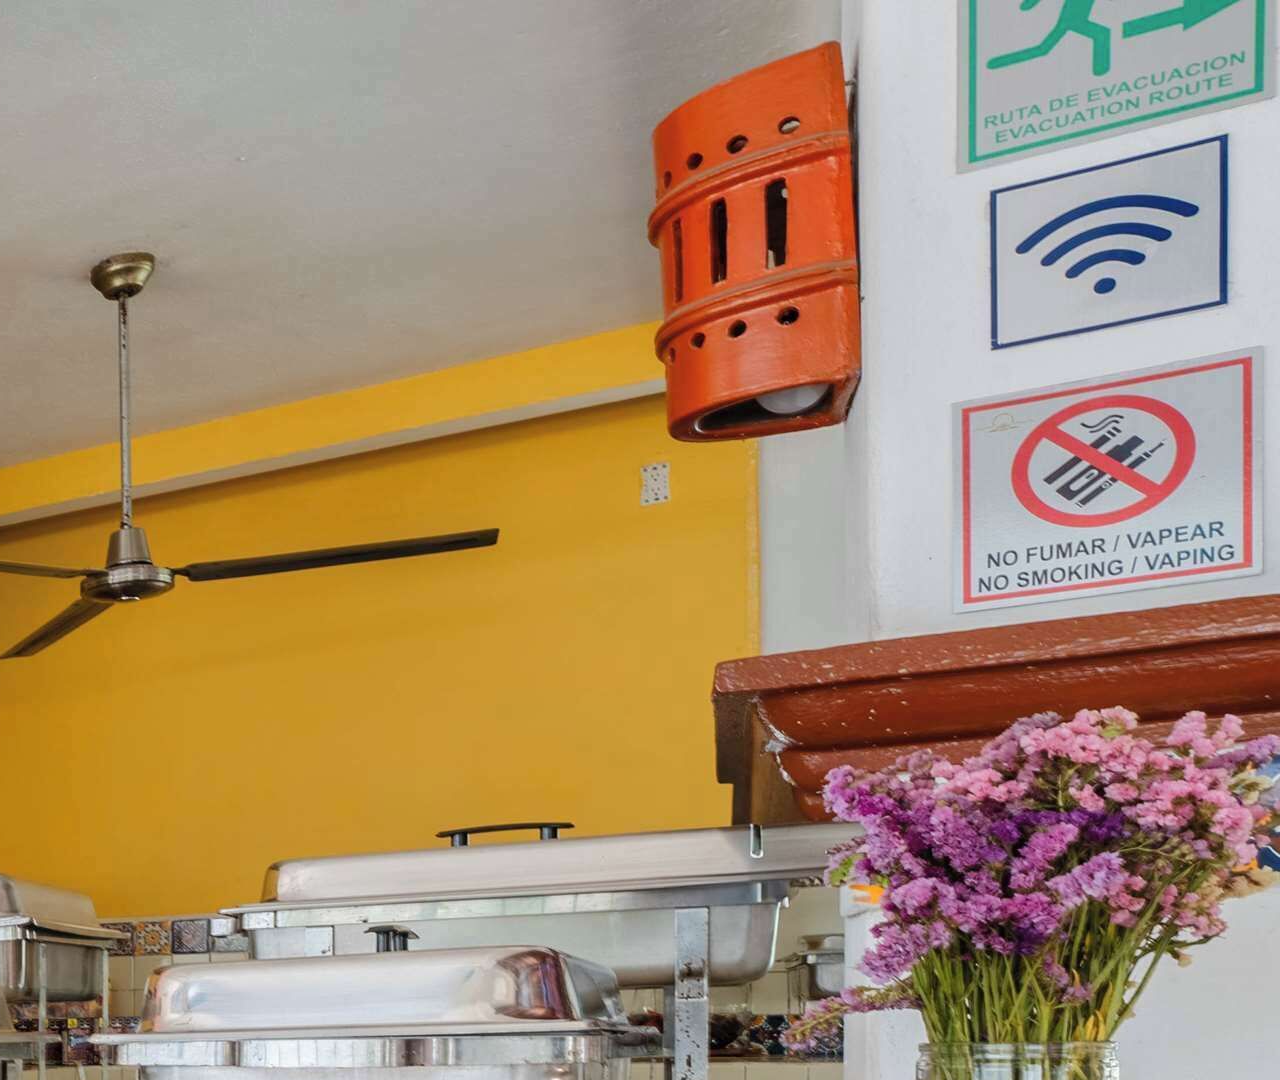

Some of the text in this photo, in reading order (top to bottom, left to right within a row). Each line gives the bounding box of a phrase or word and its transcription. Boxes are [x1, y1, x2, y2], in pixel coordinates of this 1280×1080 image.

[983, 51, 1246, 129] RUTA DE EVACUACION
[995, 73, 1233, 144] EVACUATION ROUTE
[978, 544, 1235, 593] NO SMOKING / VAPING
[987, 520, 1225, 569] NO FUMAR / VAPEAR
